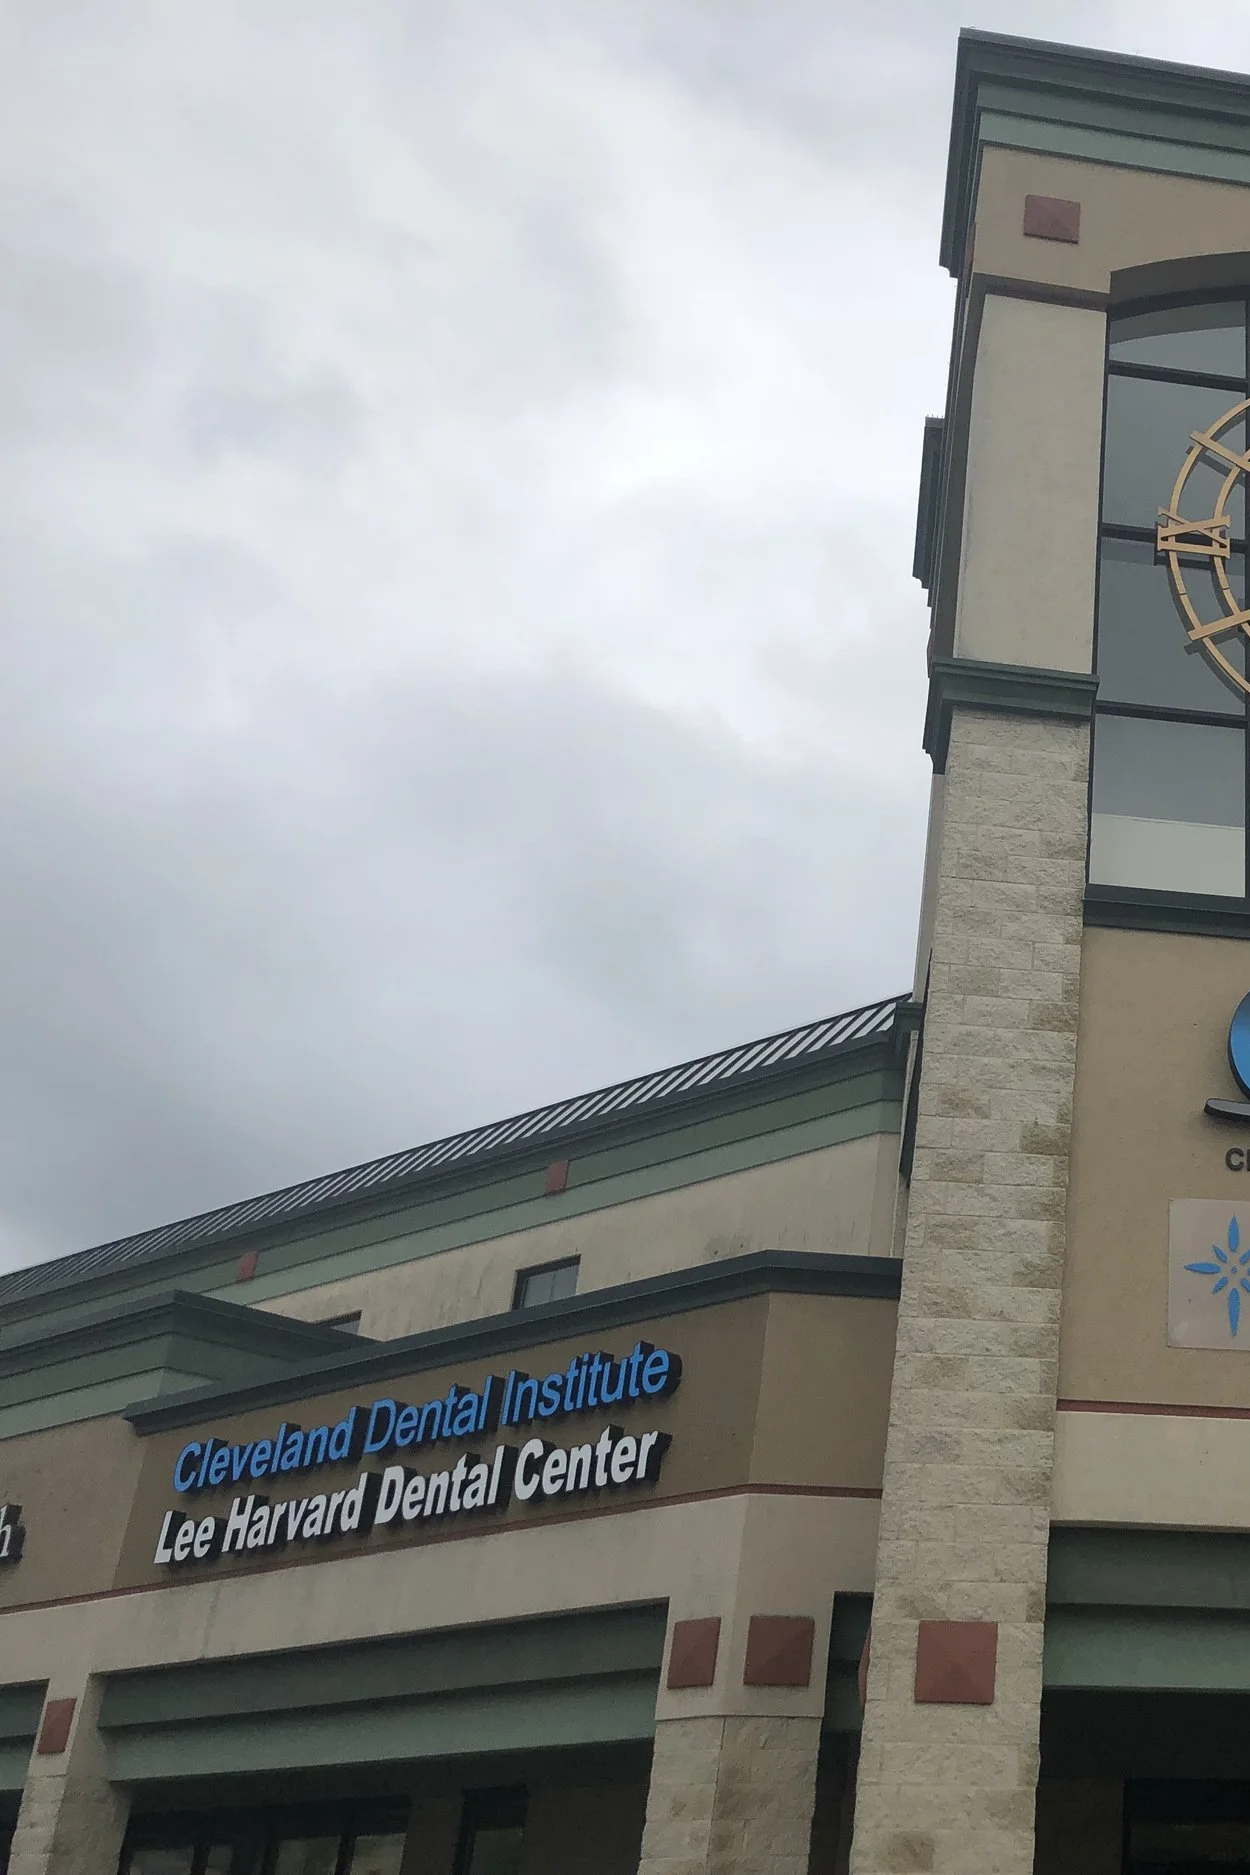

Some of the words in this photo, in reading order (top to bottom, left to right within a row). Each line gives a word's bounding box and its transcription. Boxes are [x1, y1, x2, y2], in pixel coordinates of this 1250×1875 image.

[173, 1406, 357, 1493] Cleveland
[364, 1375, 493, 1454] Dental
[502, 1340, 670, 1425] Institute
[153, 1510, 216, 1564] Lee
[221, 1472, 368, 1553] Harvard
[374, 1445, 505, 1525] Dental
[514, 1425, 659, 1501] Center
